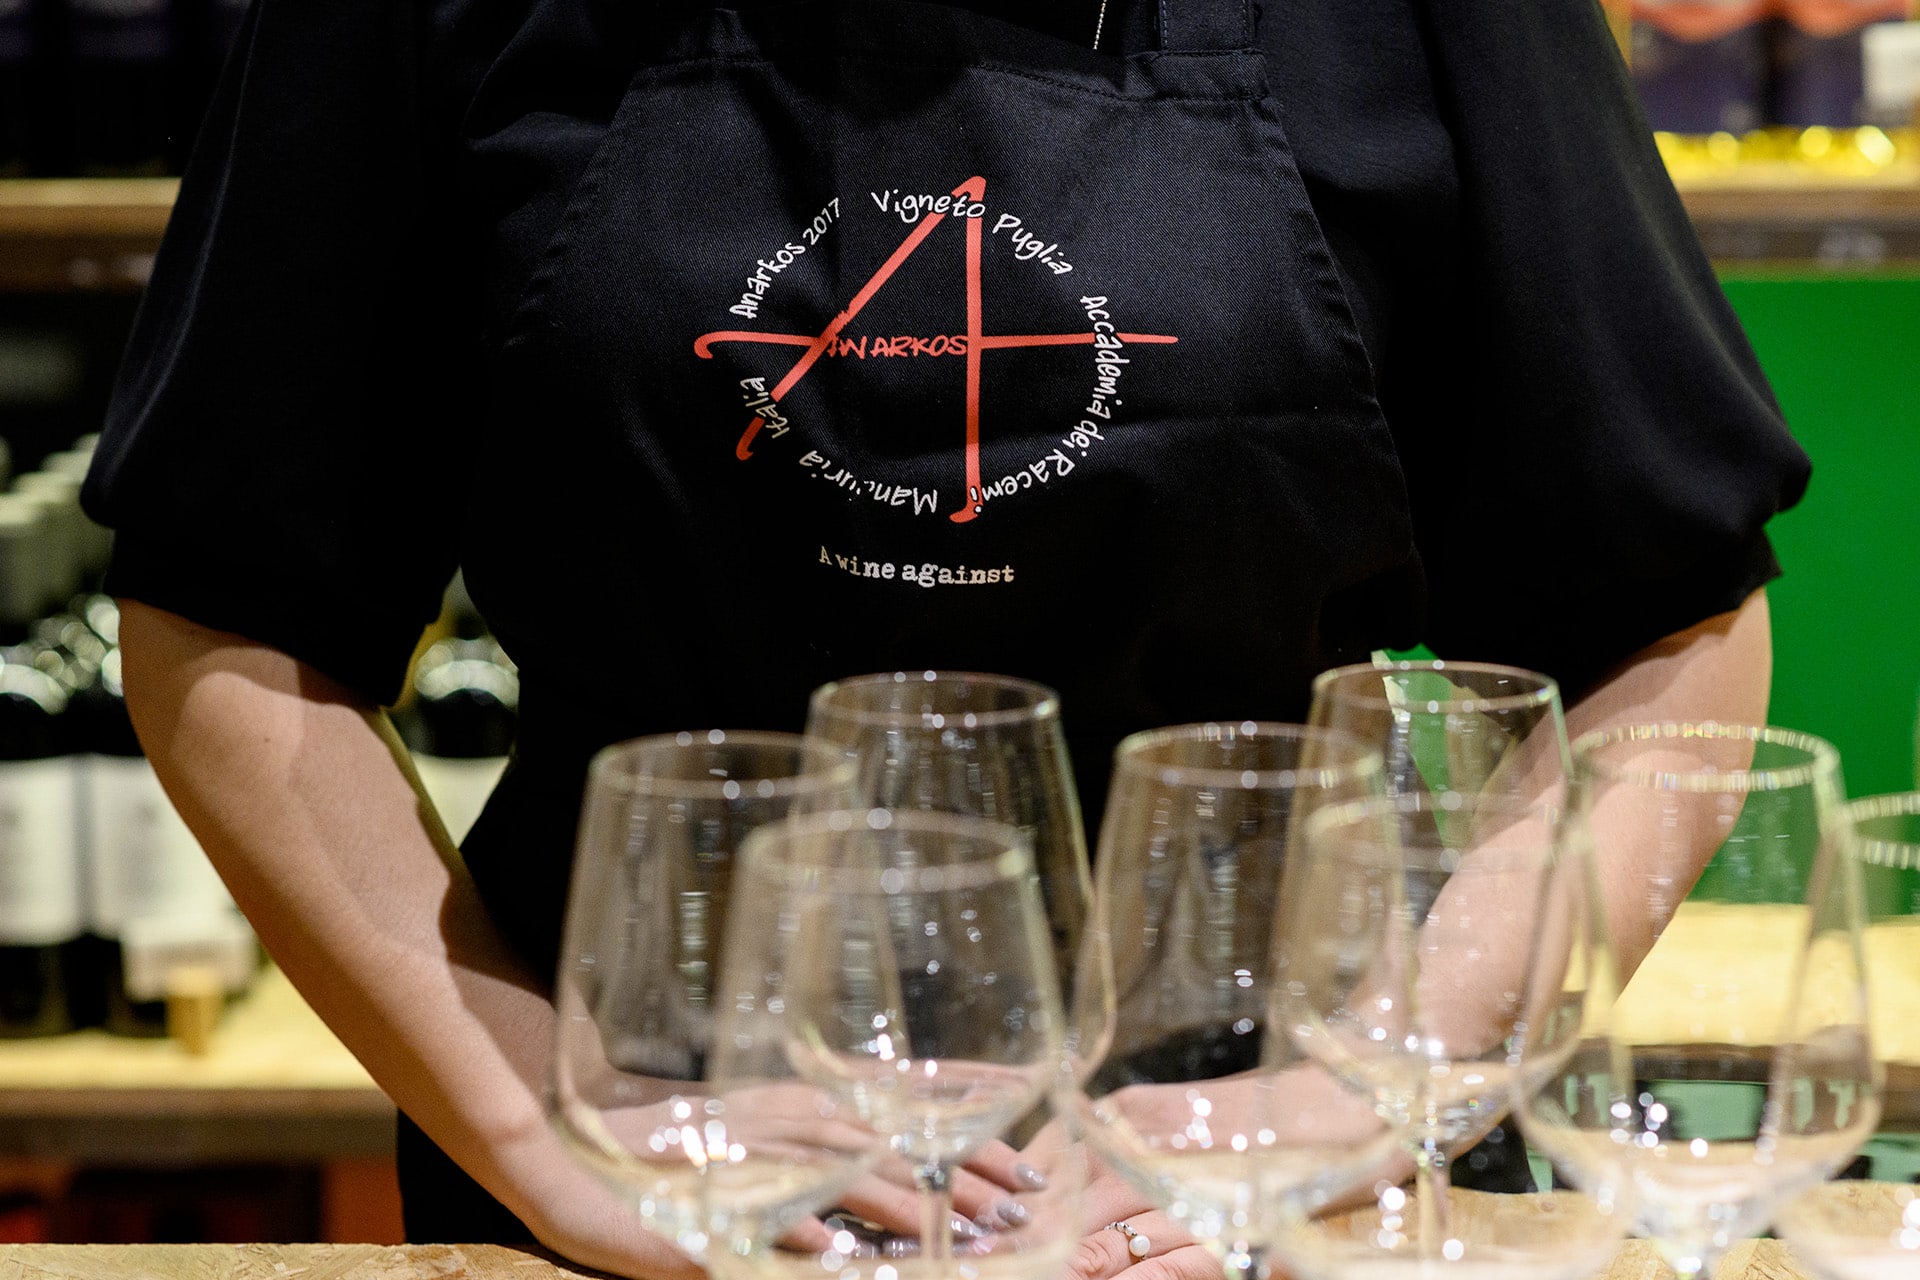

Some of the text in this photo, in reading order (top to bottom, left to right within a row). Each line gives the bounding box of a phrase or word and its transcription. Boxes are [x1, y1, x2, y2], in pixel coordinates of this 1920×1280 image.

[729, 198, 840, 319] Anarkos 2017
[871, 189, 1074, 275] Vigneto Puglia
[740, 377, 790, 439] Italia
[970, 295, 1131, 513] Accademia dei Racemi
[819, 545, 1015, 588] A wine against
